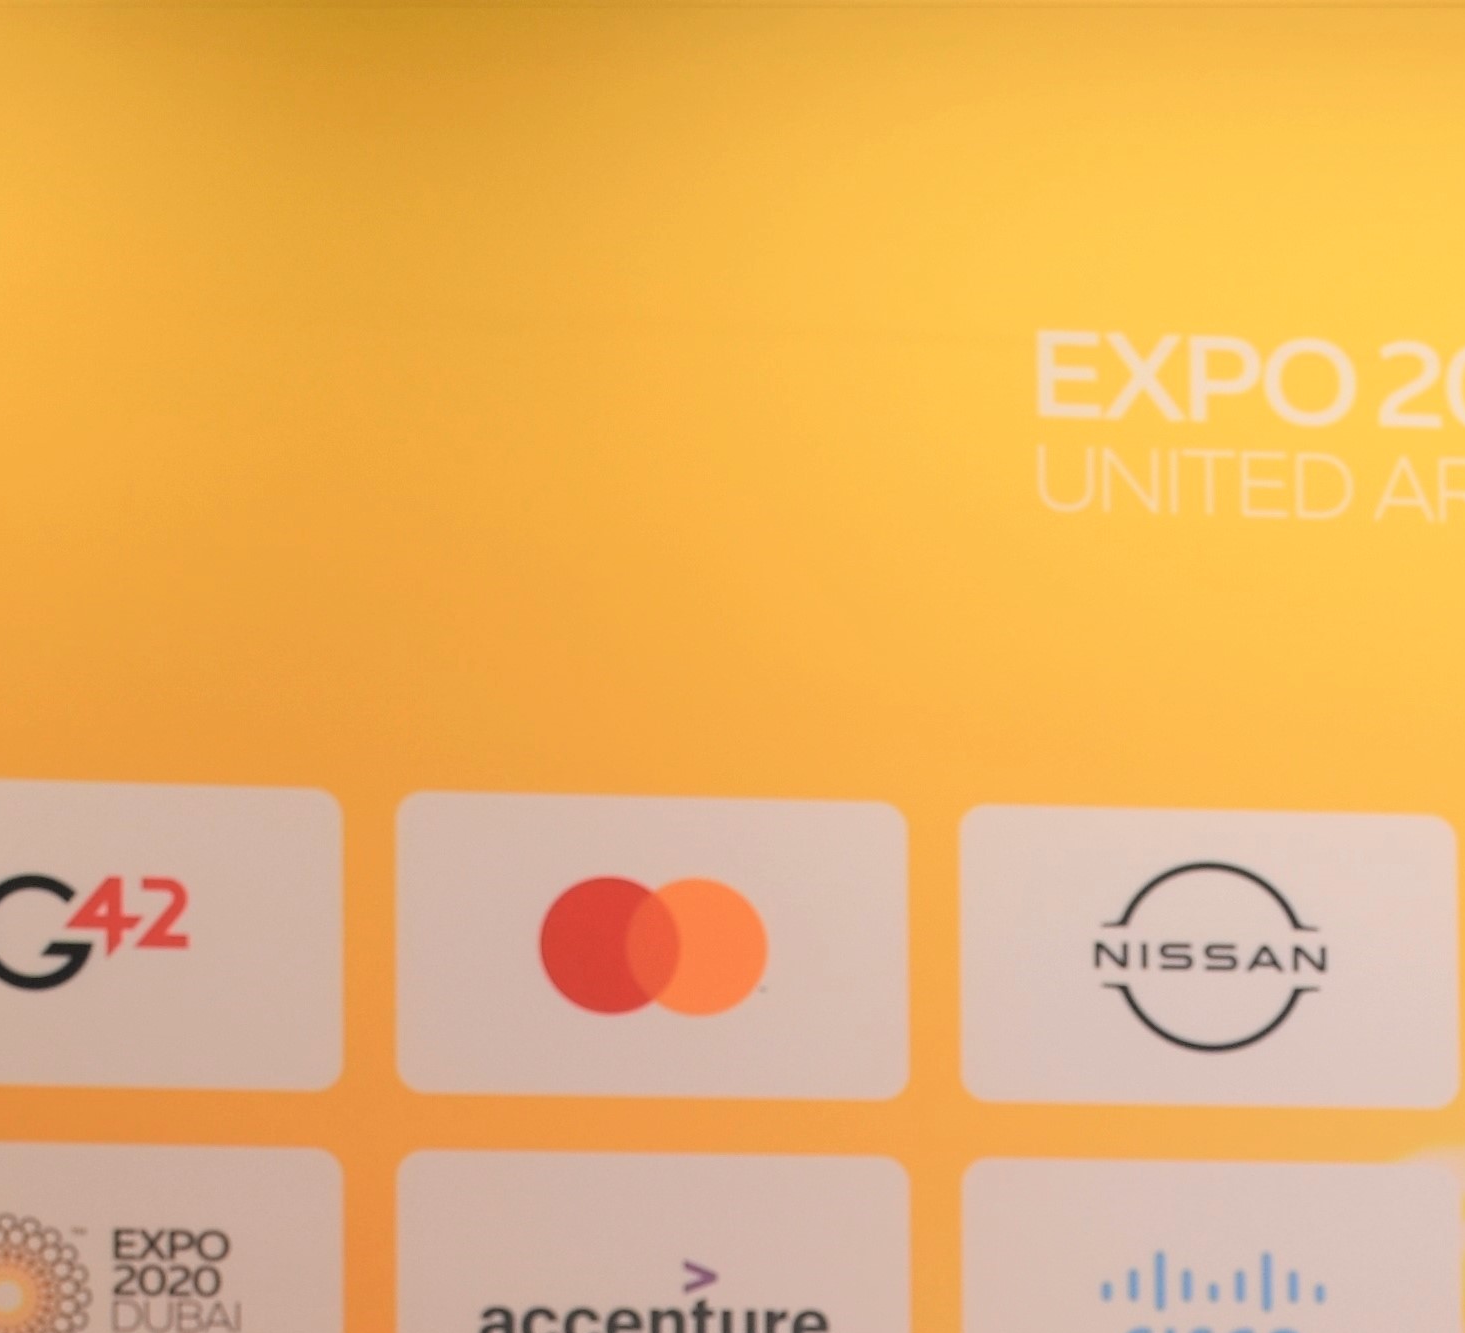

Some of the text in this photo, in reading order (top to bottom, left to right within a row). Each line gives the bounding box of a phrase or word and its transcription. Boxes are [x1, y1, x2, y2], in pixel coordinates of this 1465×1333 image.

[1037, 330, 1356, 427] EXPO
[1037, 444, 1355, 520] UNITED
[1094, 941, 1327, 972] NISSAN
[114, 1229, 229, 1261] EXPO
[111, 1265, 222, 1298] 2020
